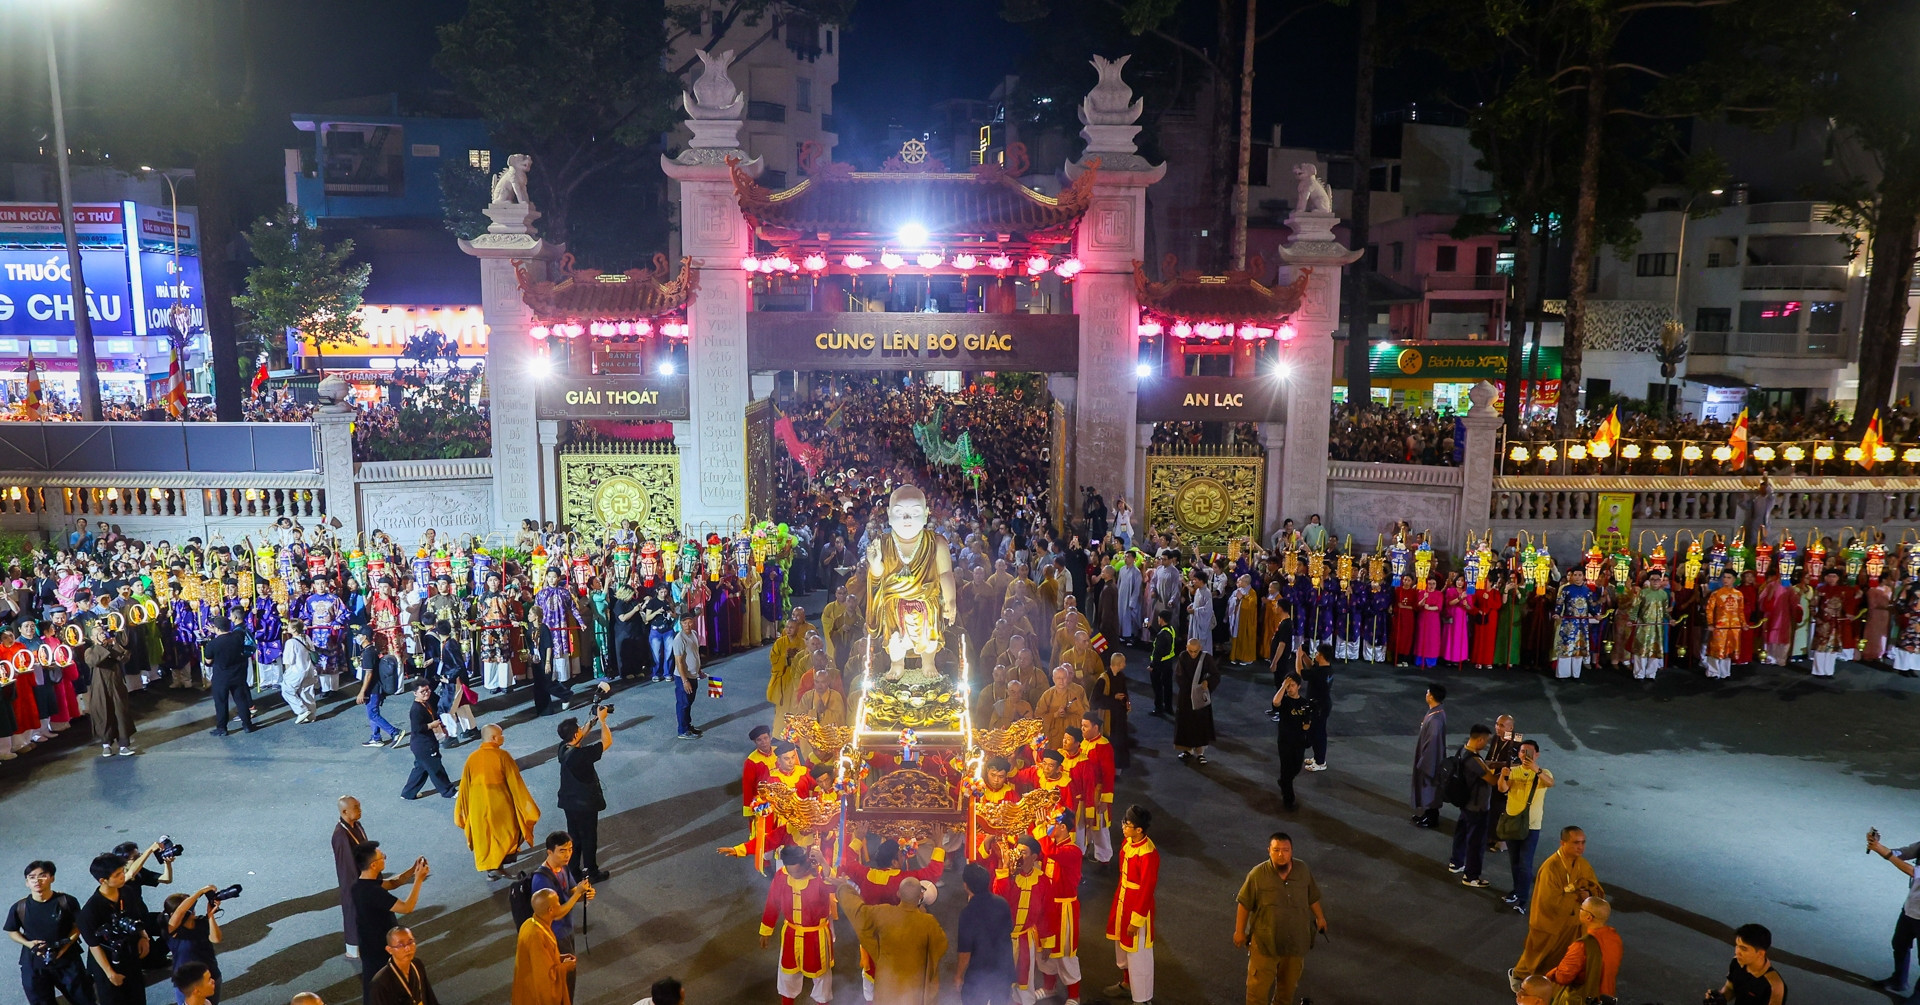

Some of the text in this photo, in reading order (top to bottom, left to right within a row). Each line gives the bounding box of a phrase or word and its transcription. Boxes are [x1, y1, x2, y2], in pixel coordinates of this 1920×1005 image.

[88, 210, 114, 222] THƯ
[156, 280, 190, 298] NHÀ THỐC
[815, 328, 1013, 351] CÙNG LÊN BỜ GIÁC
[1428, 355, 1454, 368] Bách
[1455, 355, 1475, 368] hóa
[565, 386, 659, 405] GIẢI THOÁT
[1182, 393, 1244, 410] AN LẠC
[380, 510, 483, 529] TRANG NGHIÊM
